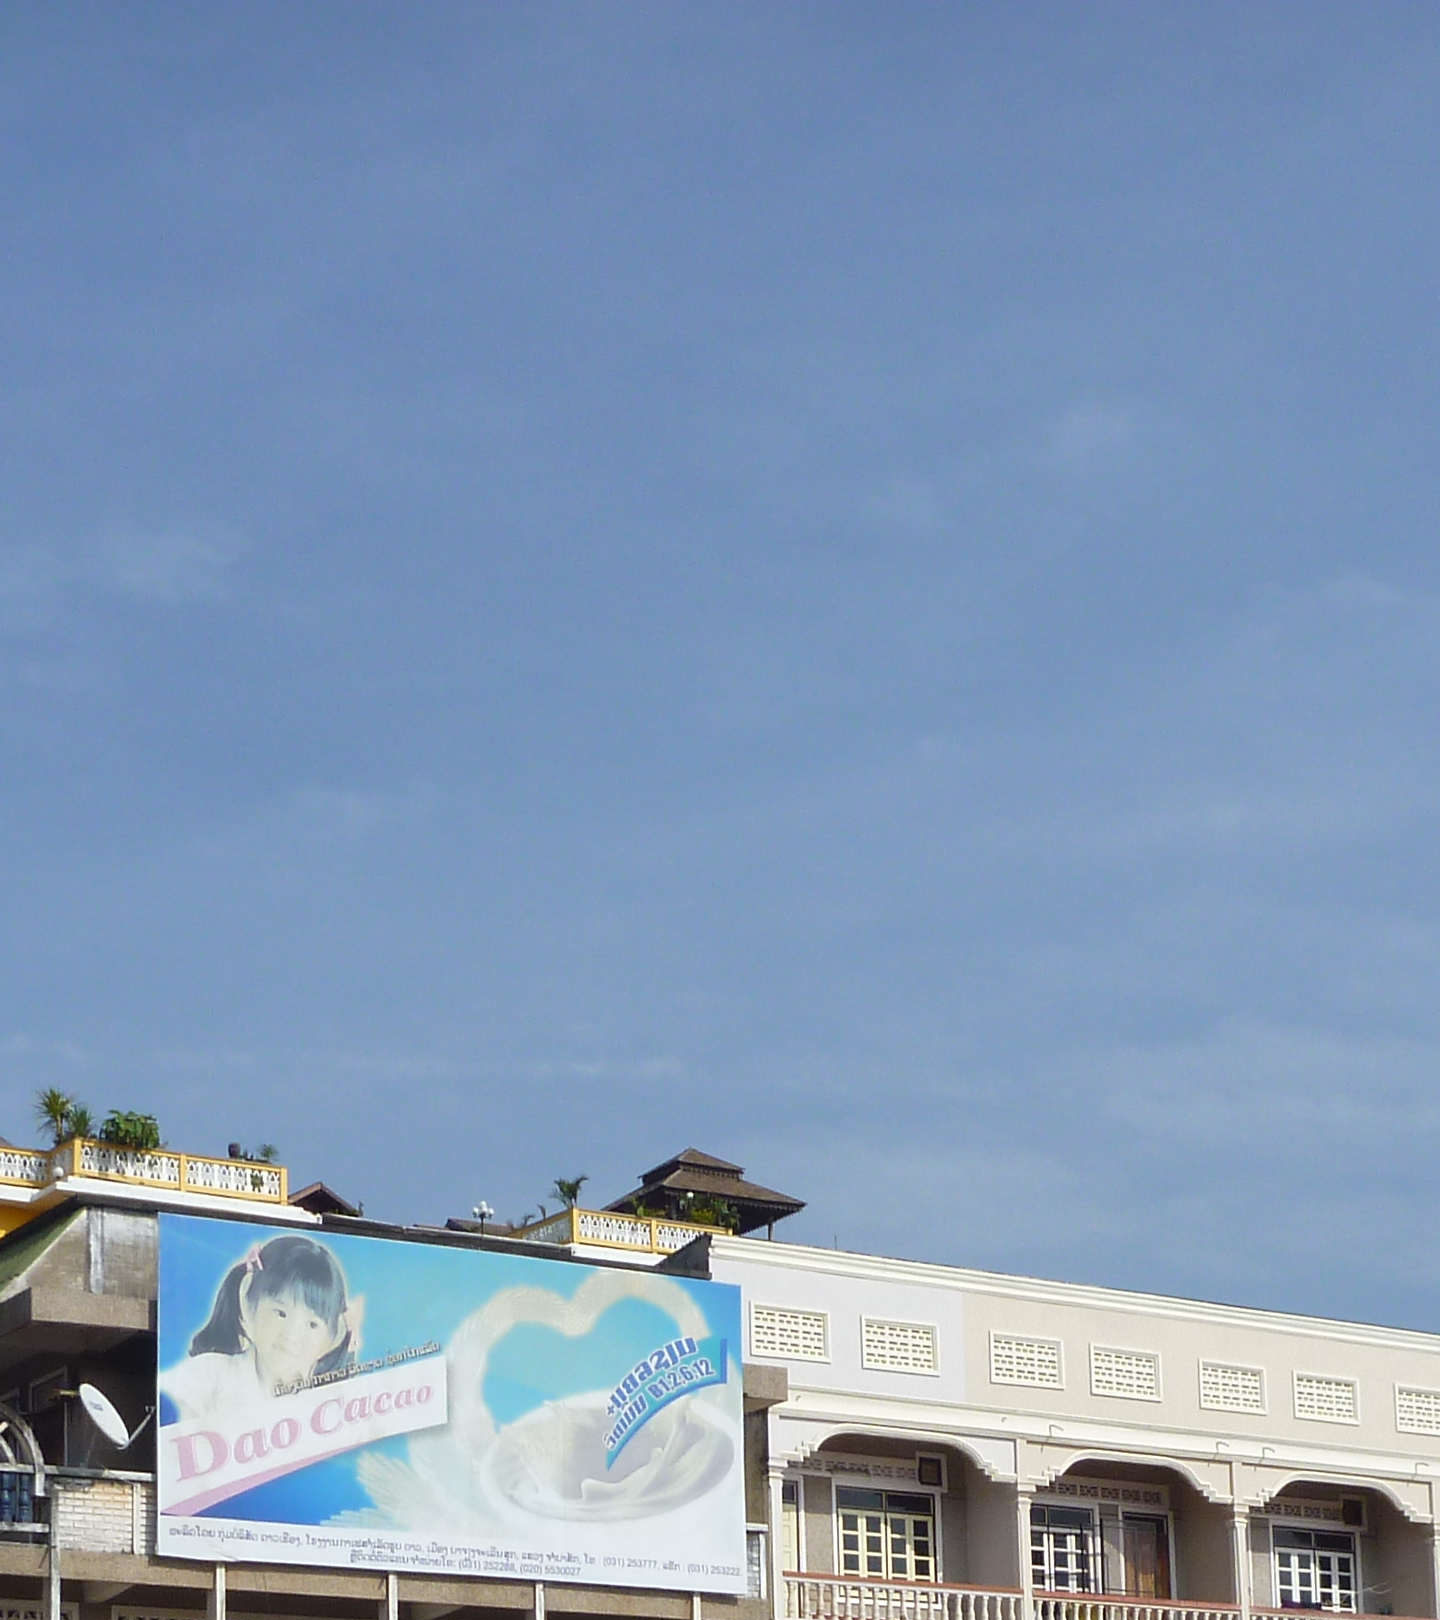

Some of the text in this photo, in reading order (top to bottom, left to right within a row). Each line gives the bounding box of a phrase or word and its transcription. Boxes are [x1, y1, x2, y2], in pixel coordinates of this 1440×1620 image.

[646, 1358, 715, 1399] B1,2,6,12
[169, 1384, 434, 1483] Dao Cacao
